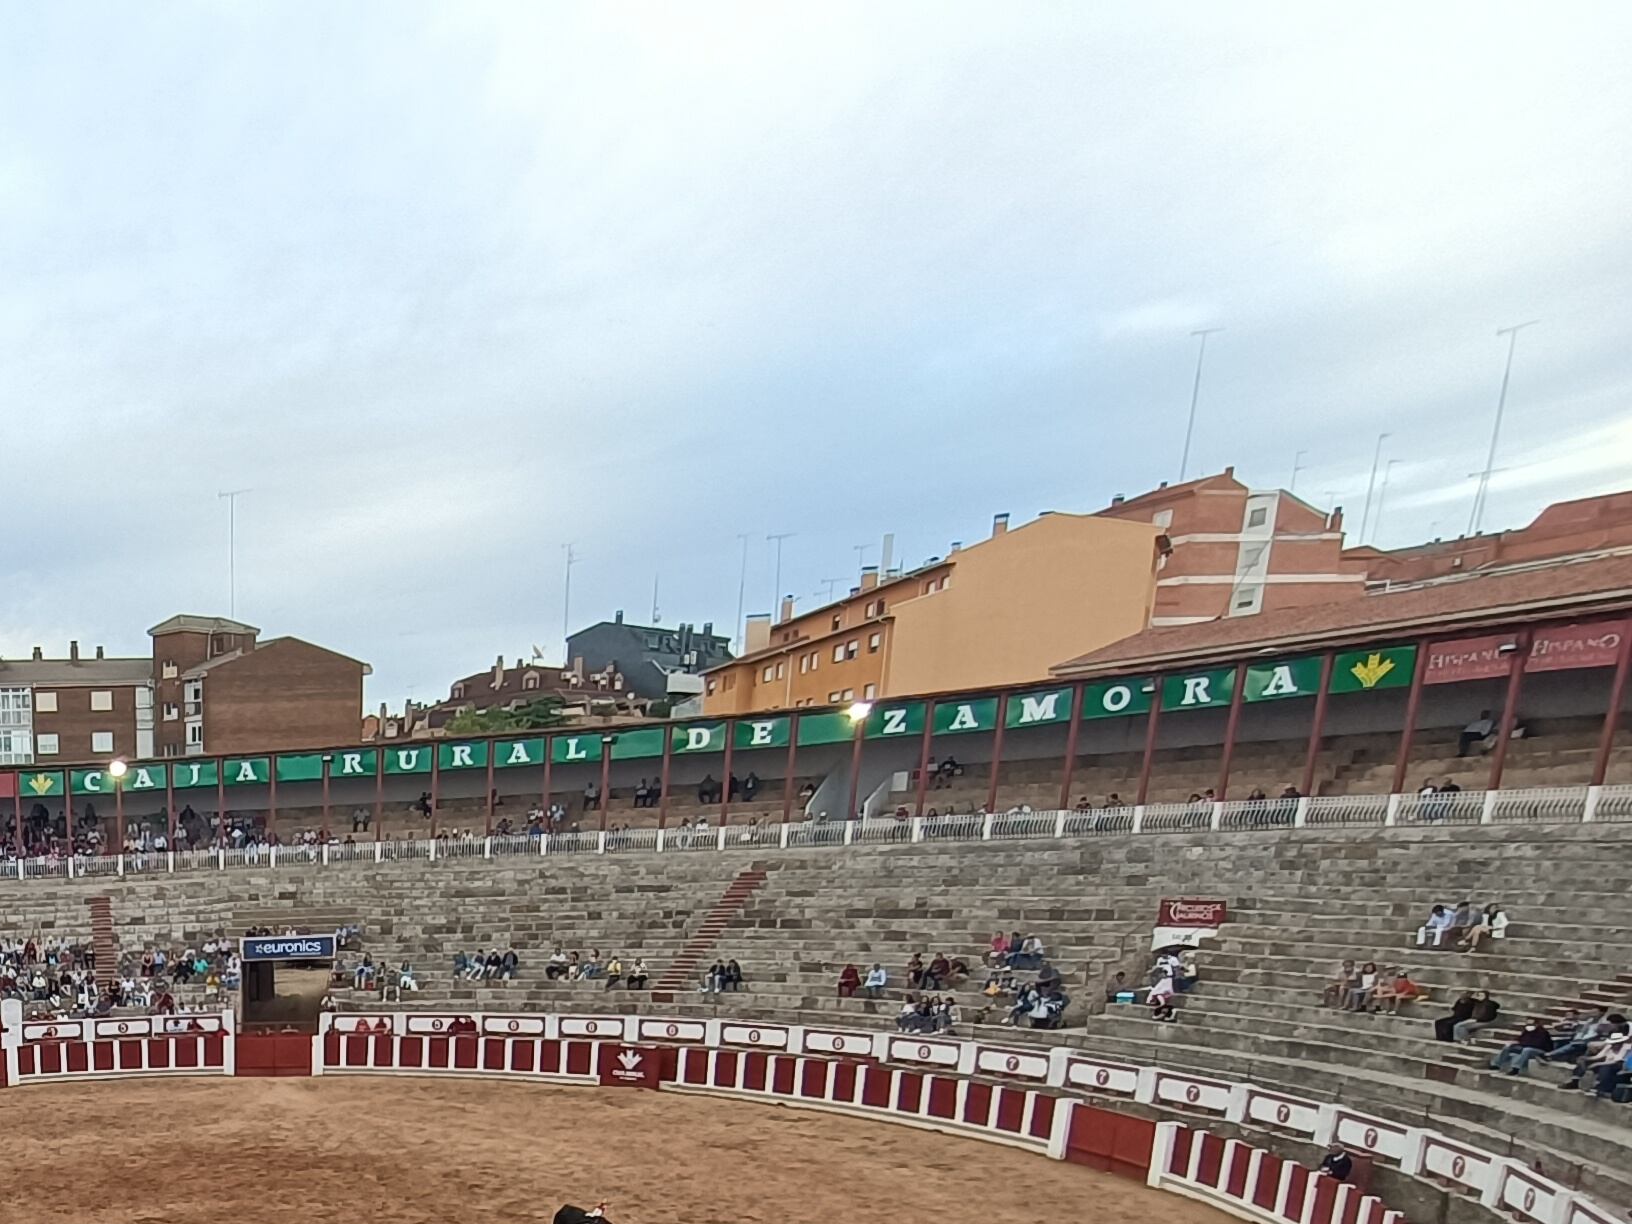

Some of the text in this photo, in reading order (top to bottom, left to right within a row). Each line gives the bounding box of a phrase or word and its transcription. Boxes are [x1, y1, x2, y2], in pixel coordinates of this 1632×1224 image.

[1428, 643, 1514, 669] HISPAN
[83, 665, 1298, 791] CAJA RURAL DE ZAMORA
[263, 940, 321, 954] euronics
